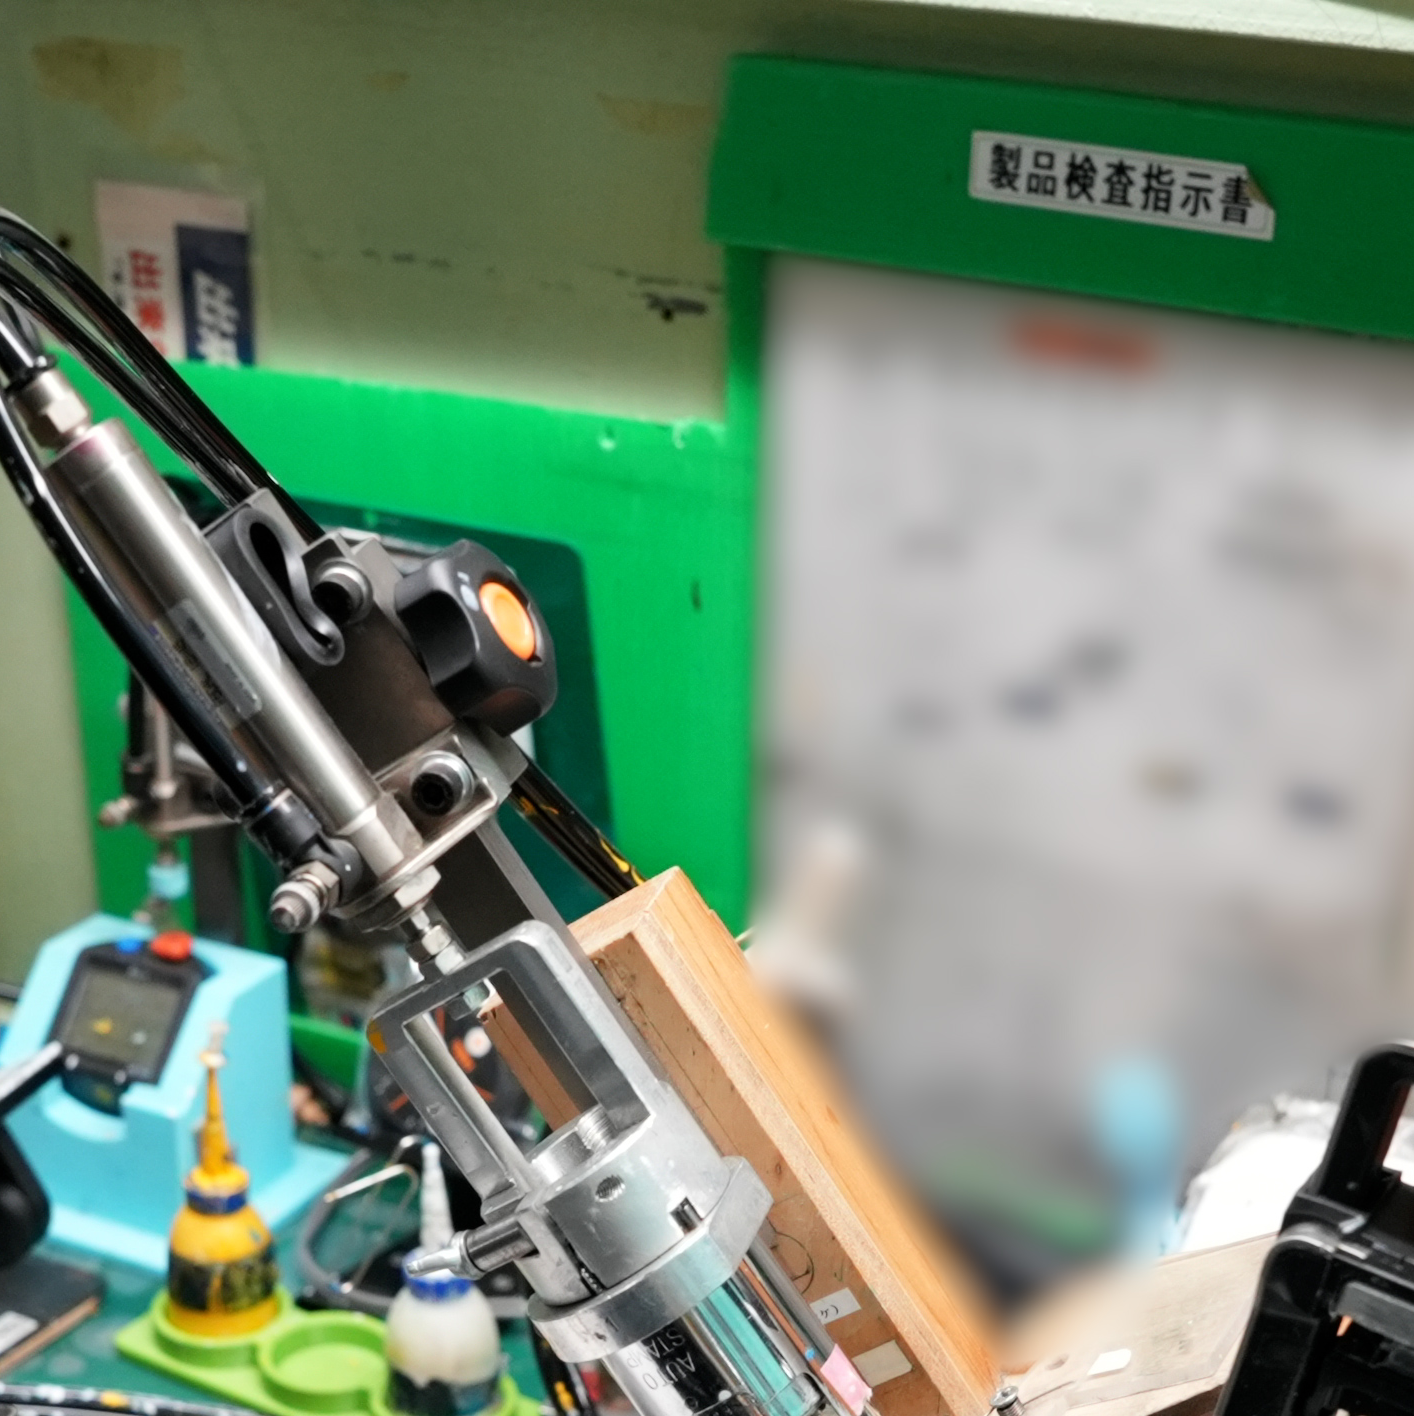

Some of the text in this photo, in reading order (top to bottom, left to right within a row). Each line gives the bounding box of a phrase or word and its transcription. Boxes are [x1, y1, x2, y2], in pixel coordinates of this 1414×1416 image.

[989, 143, 1253, 225] 製品検査指示書
[626, 1329, 686, 1369] STAMP
[641, 1352, 696, 1391] AUTO
